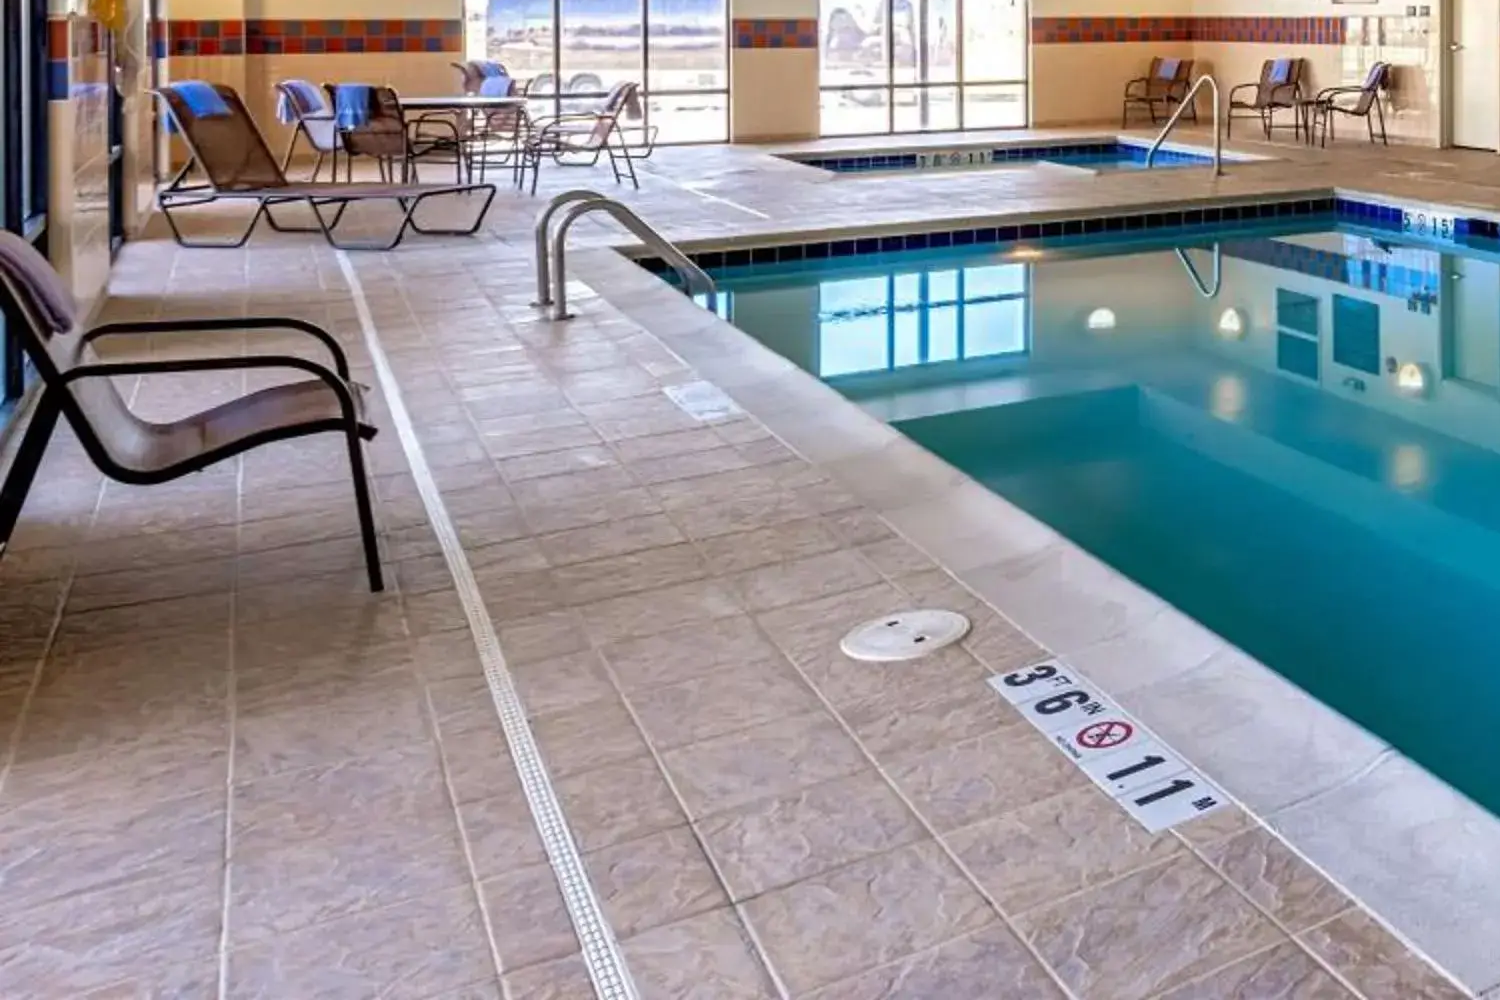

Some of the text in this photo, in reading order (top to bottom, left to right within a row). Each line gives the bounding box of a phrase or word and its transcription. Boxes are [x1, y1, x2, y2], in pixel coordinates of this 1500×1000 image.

[1004, 664, 1218, 811] 3 FT 6 IN 1.1 M
